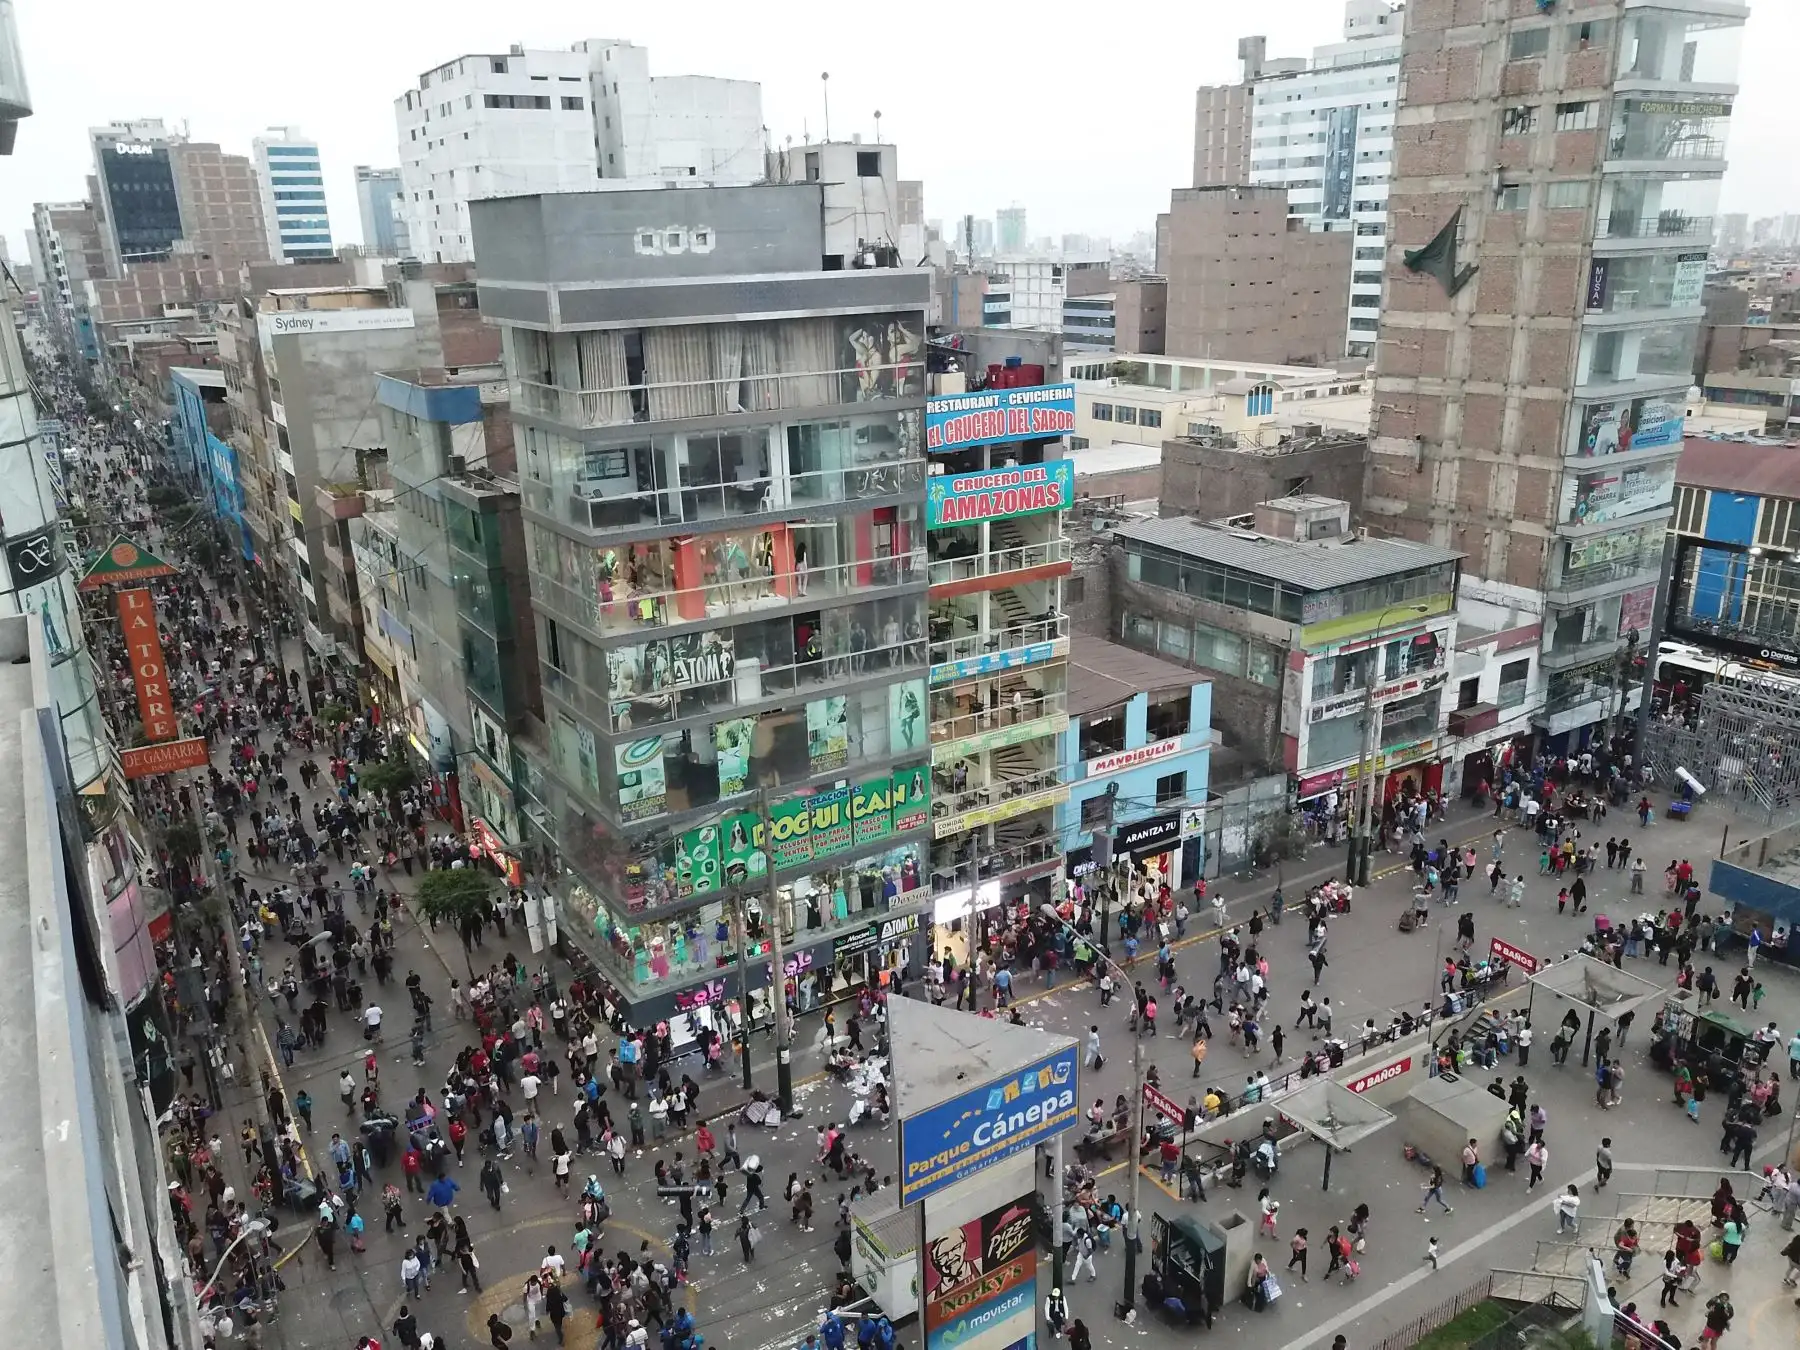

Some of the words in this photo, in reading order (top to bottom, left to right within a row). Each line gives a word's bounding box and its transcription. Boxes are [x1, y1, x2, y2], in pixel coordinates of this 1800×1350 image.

[275, 317, 314, 330] Sydney
[926, 395, 1000, 414] RESTAURANT
[1008, 387, 1074, 405] CEVICHERIA
[927, 425, 943, 448] EL
[944, 409, 1006, 443] CRUCERO
[1007, 407, 1031, 436] DEL
[1032, 408, 1075, 433] SABOR
[953, 471, 1021, 493] CRUCERO
[1022, 468, 1048, 482] DEL
[941, 482, 1061, 524] AMAZONAS
[102, 567, 169, 582] COMERCIAL
[127, 594, 148, 629] LA
[136, 643, 169, 737] TORRE
[125, 750, 142, 769] DE
[143, 742, 204, 765] GAMARRA
[845, 784, 907, 820] CAN
[938, 818, 965, 830] COMIDAS
[1126, 826, 1163, 845] ARANTZA
[783, 845, 808, 858] VENTAS
[1502, 947, 1533, 968] BAÑOS
[1366, 1064, 1402, 1089] BAÑOS
[1153, 1095, 1184, 1123] BAÑOS
[908, 1138, 970, 1178] Parque
[972, 1088, 1073, 1146] Cánepa
[956, 1154, 999, 1180] Gamarra
[987, 1215, 1032, 1259] Pizza
[996, 1228, 1026, 1260] Hut
[941, 1263, 1023, 1318] Norky's
[969, 1292, 1024, 1329] movistar
